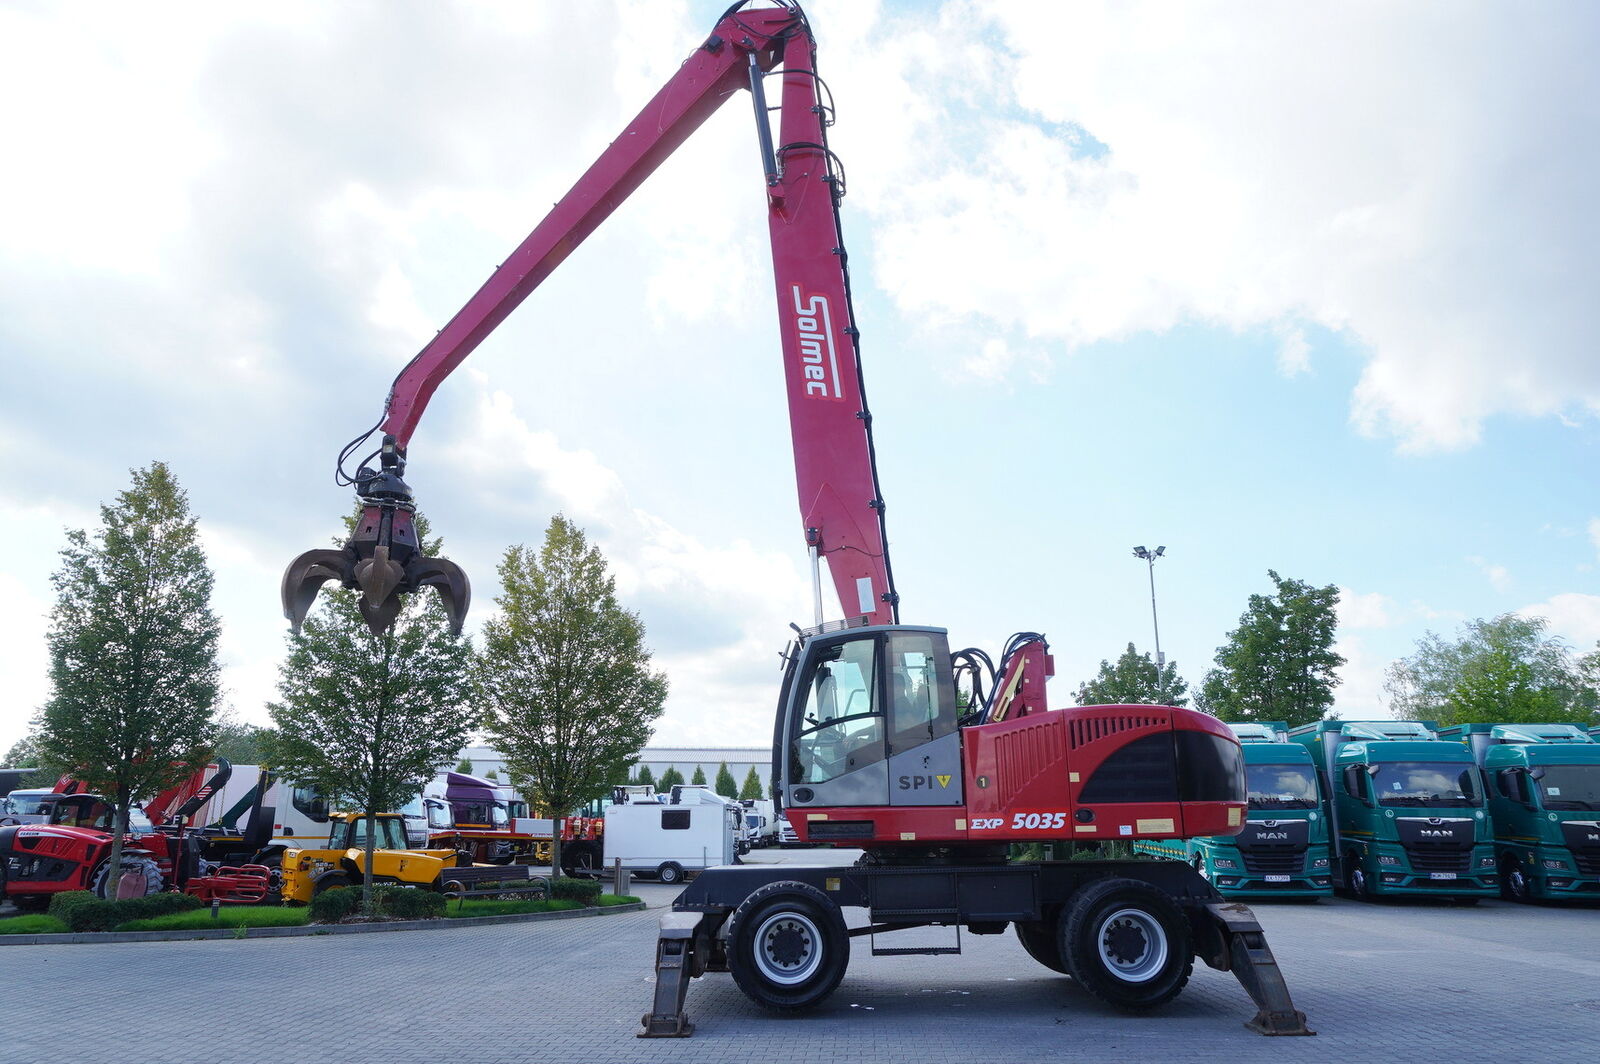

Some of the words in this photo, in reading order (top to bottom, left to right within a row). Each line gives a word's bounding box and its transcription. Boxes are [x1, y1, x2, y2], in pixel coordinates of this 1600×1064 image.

[792, 286, 842, 398] Solmec
[980, 777, 986, 788] 1
[971, 818, 1004, 830] EXP
[1011, 812, 1067, 830] 5035
